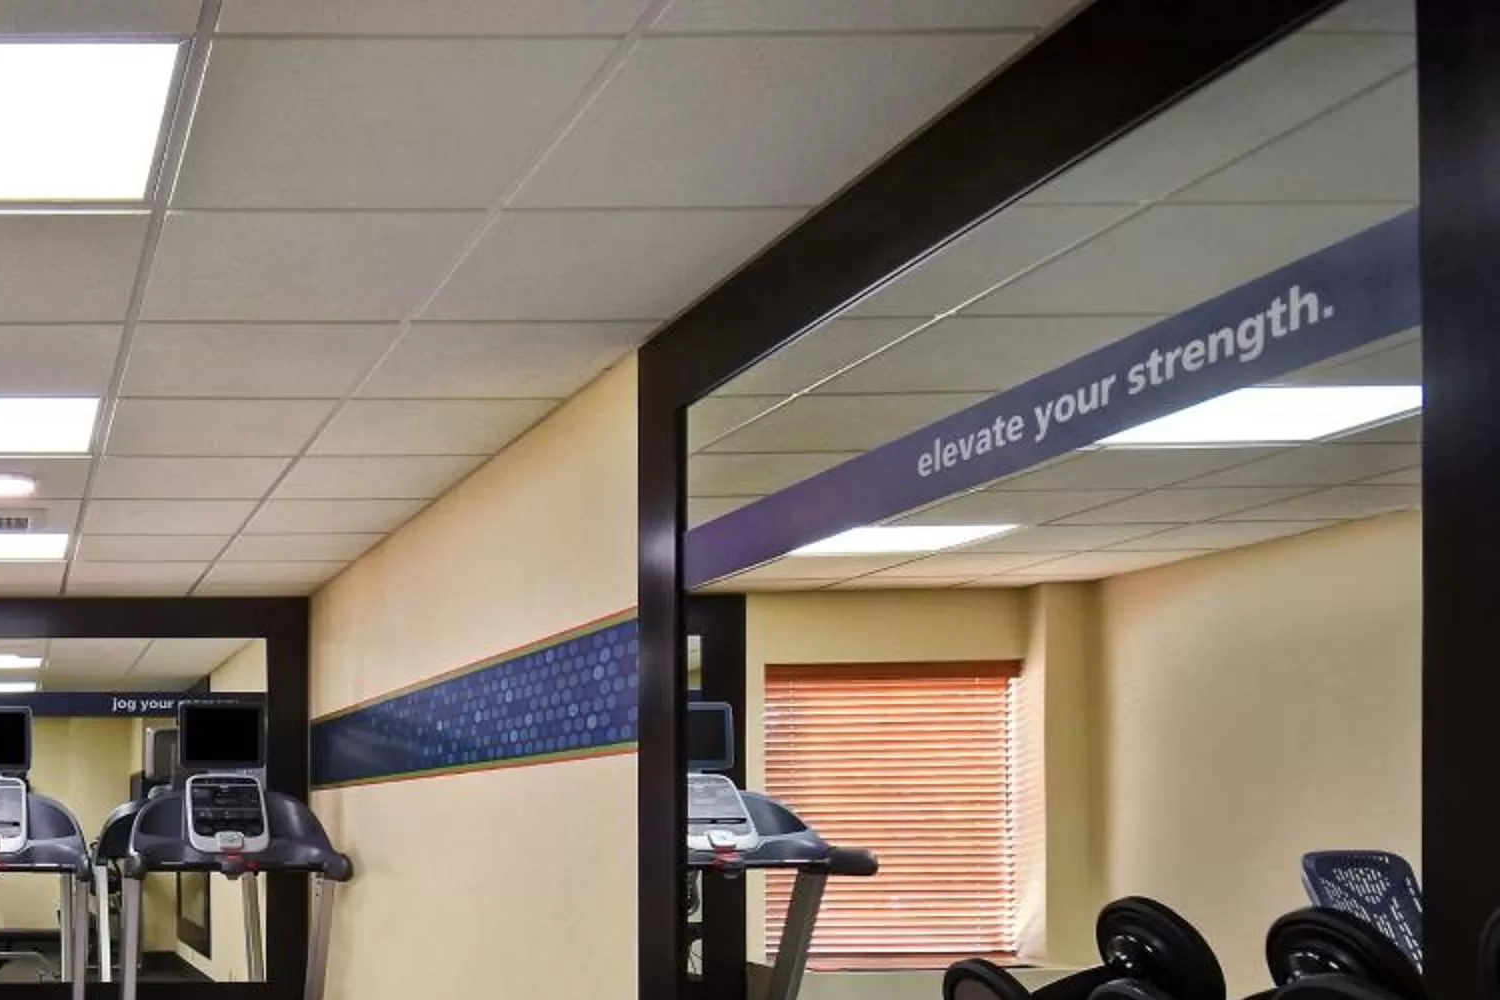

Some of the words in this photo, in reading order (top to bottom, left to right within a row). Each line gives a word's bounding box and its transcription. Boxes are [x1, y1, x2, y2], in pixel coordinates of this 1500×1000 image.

[917, 413, 1024, 478] elevate
[1033, 373, 1117, 442] your
[1126, 285, 1335, 396] strength.
[112, 697, 137, 712] jog
[140, 699, 175, 712] your
